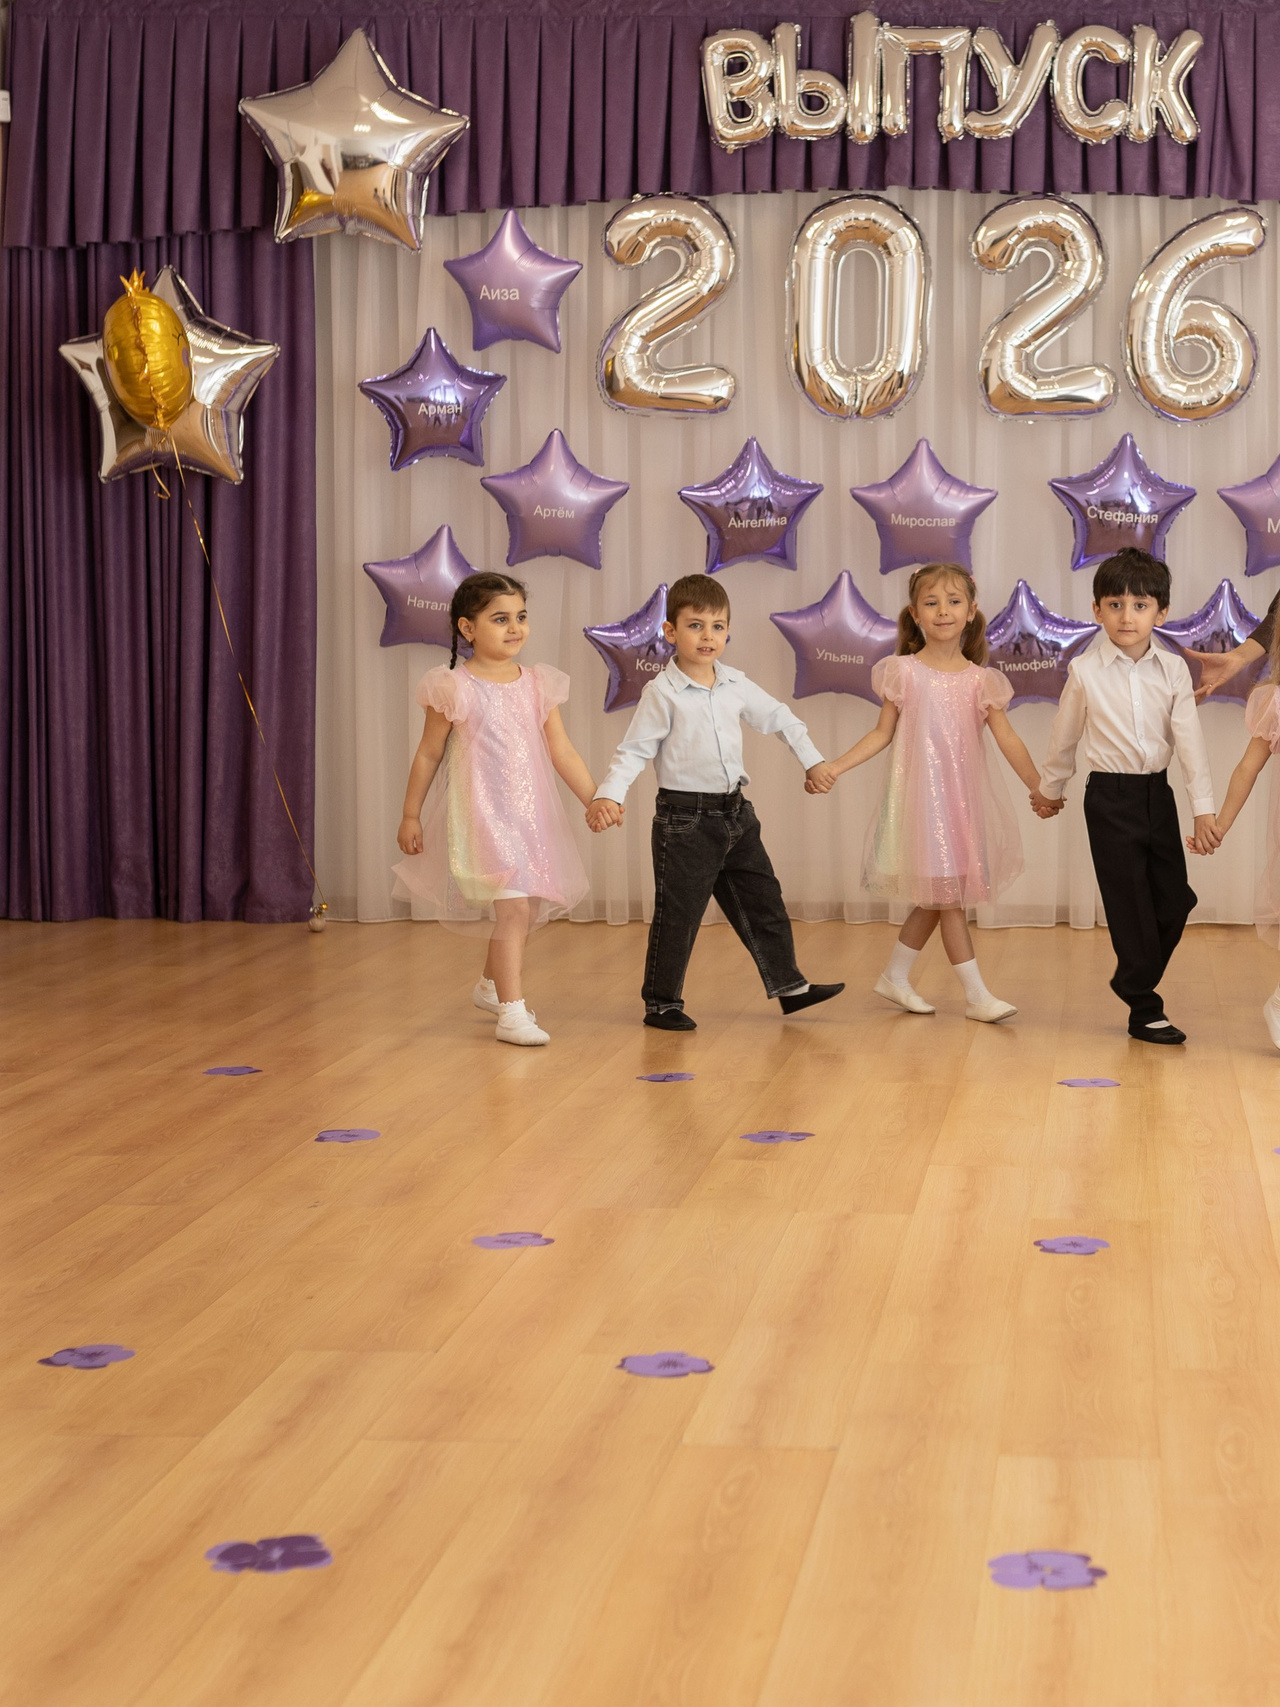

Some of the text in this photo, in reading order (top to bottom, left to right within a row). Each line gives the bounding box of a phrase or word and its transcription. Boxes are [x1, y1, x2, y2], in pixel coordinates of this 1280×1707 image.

[703, 10, 1203, 151] ВЫПУСК
[479, 285, 520, 301] Аиза
[601, 194, 1268, 422] 2026
[417, 403, 463, 416] Арман
[533, 505, 575, 519] Артём
[1087, 505, 1159, 524] Стефания
[727, 516, 788, 529] Ангелина
[890, 513, 956, 528] Мирослав
[815, 648, 864, 664] Ульяна
[996, 657, 1057, 672] Тимофей
